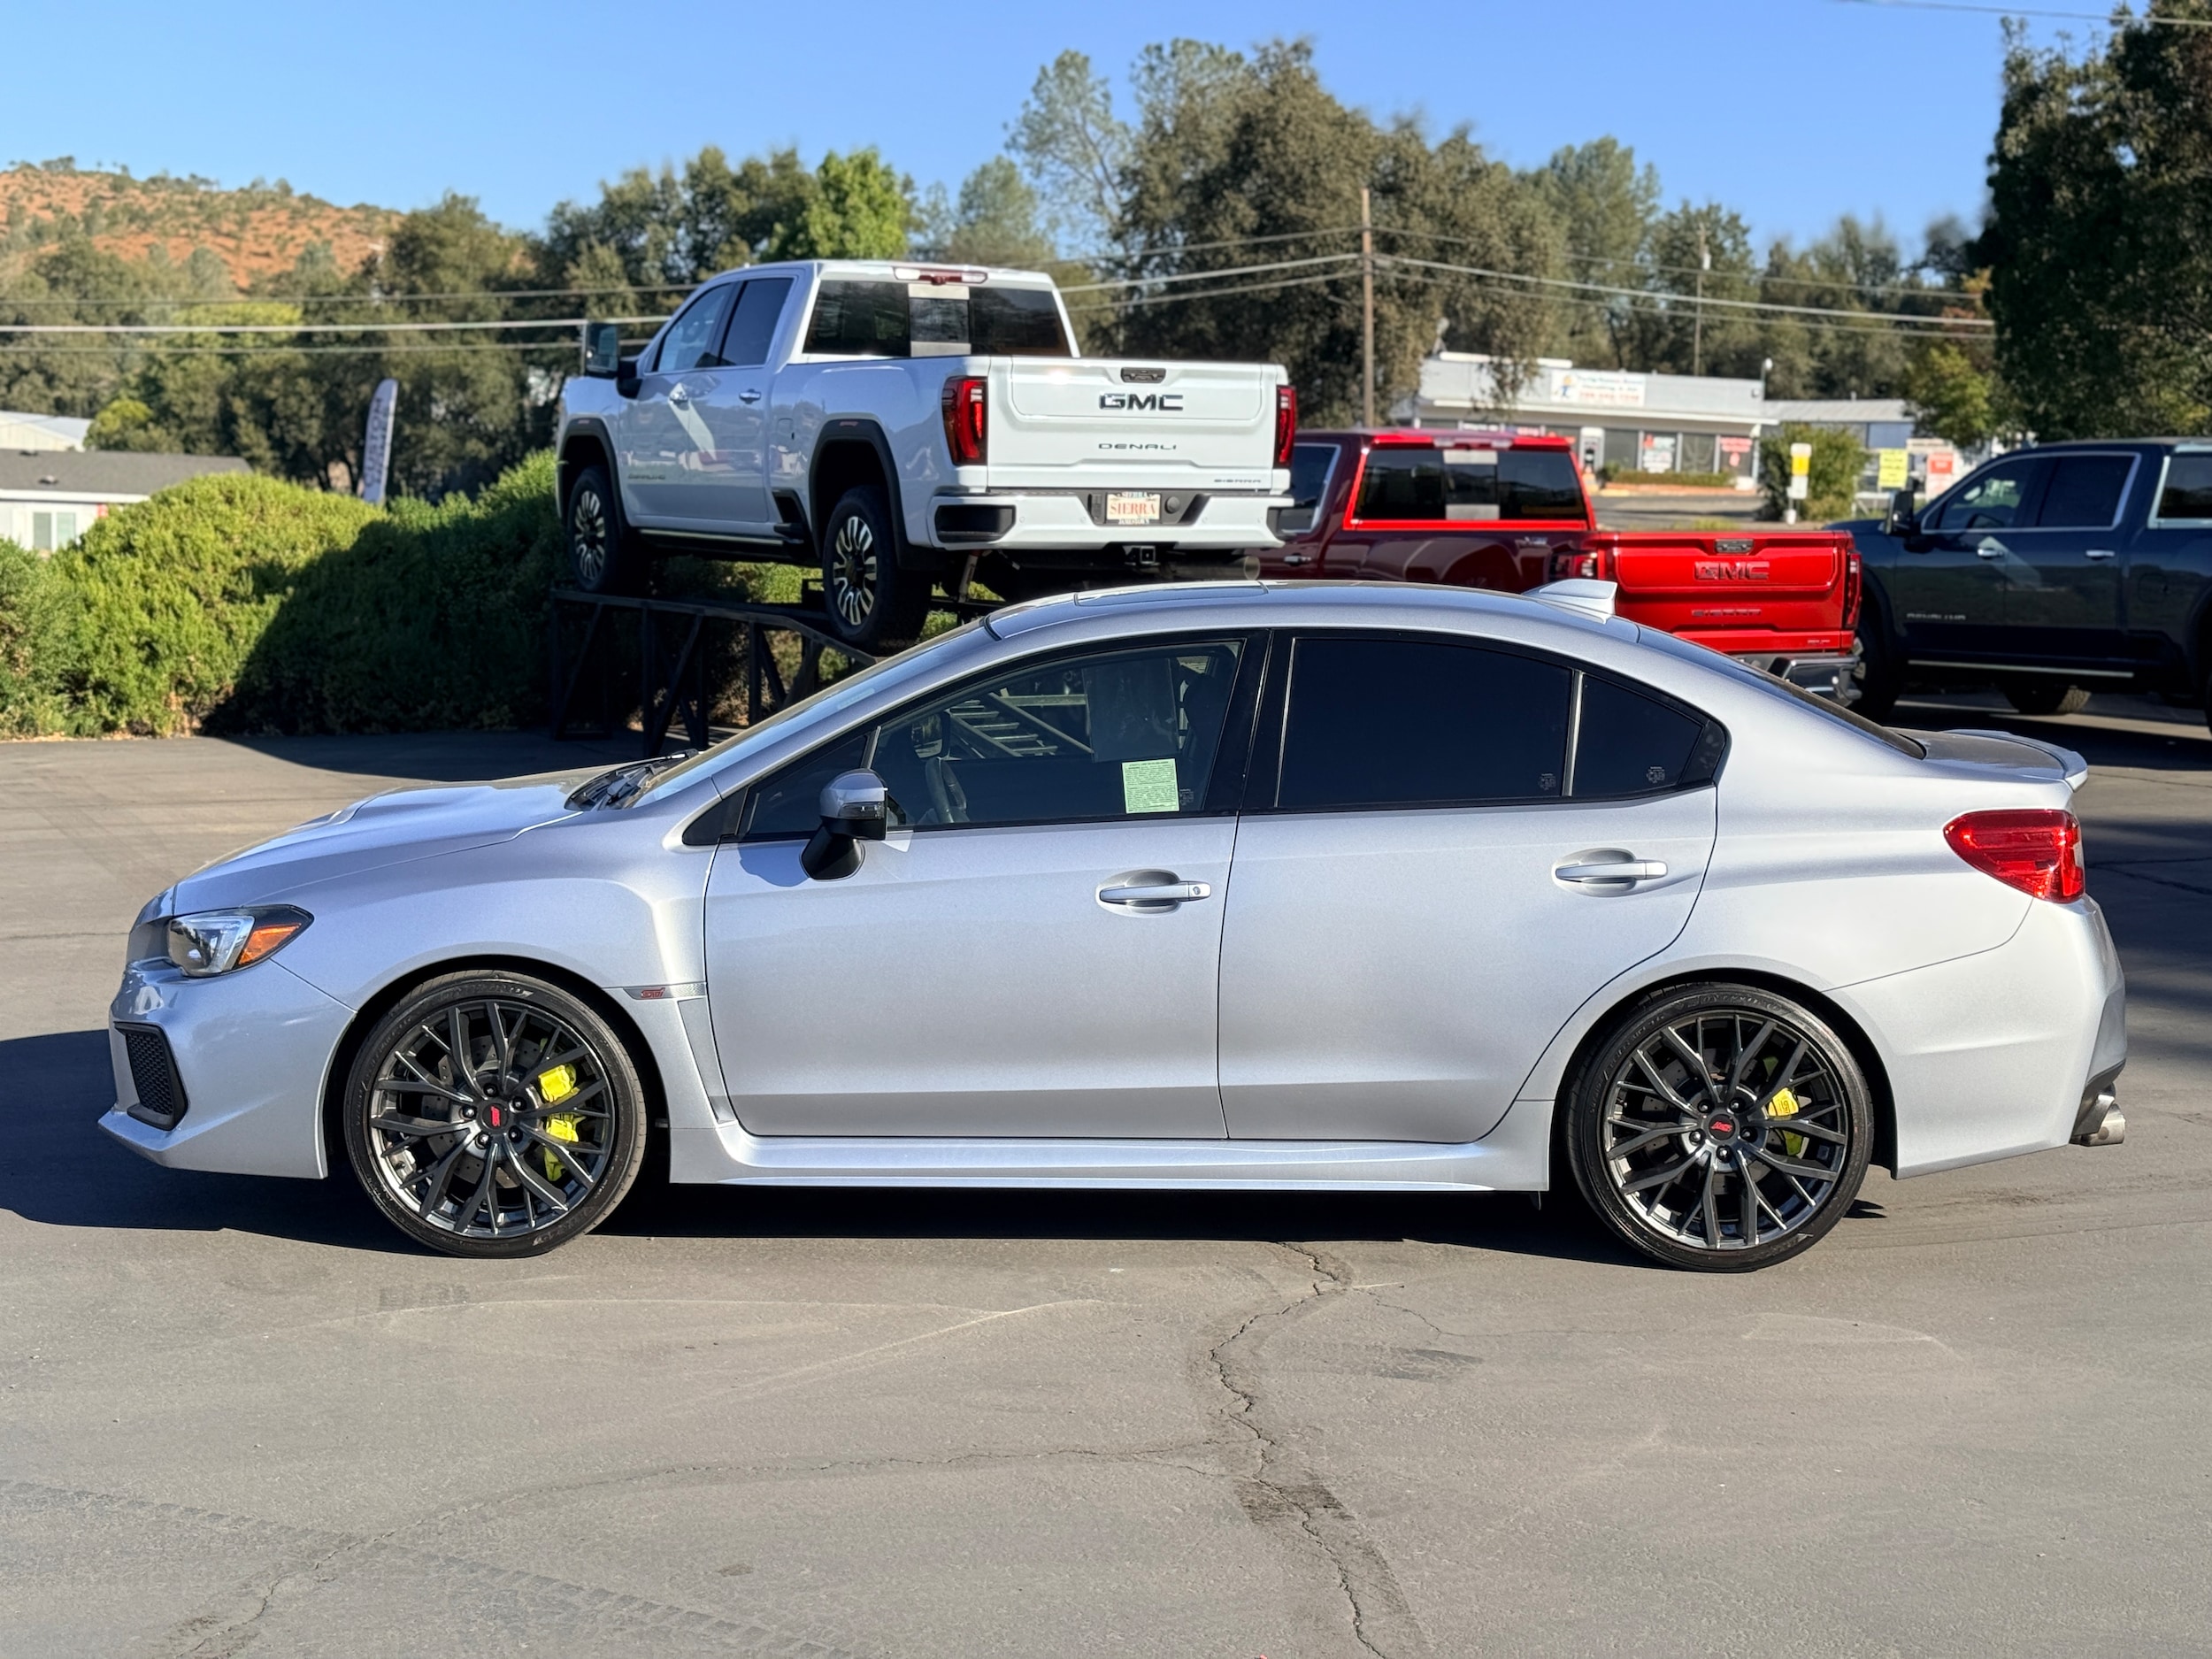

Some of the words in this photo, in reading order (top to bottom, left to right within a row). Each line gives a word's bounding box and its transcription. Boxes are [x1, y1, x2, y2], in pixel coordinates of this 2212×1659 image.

[1099, 393, 1184, 411] GMC
[1110, 502, 1156, 515] SIERRA
[1694, 561, 1770, 580] GMC
